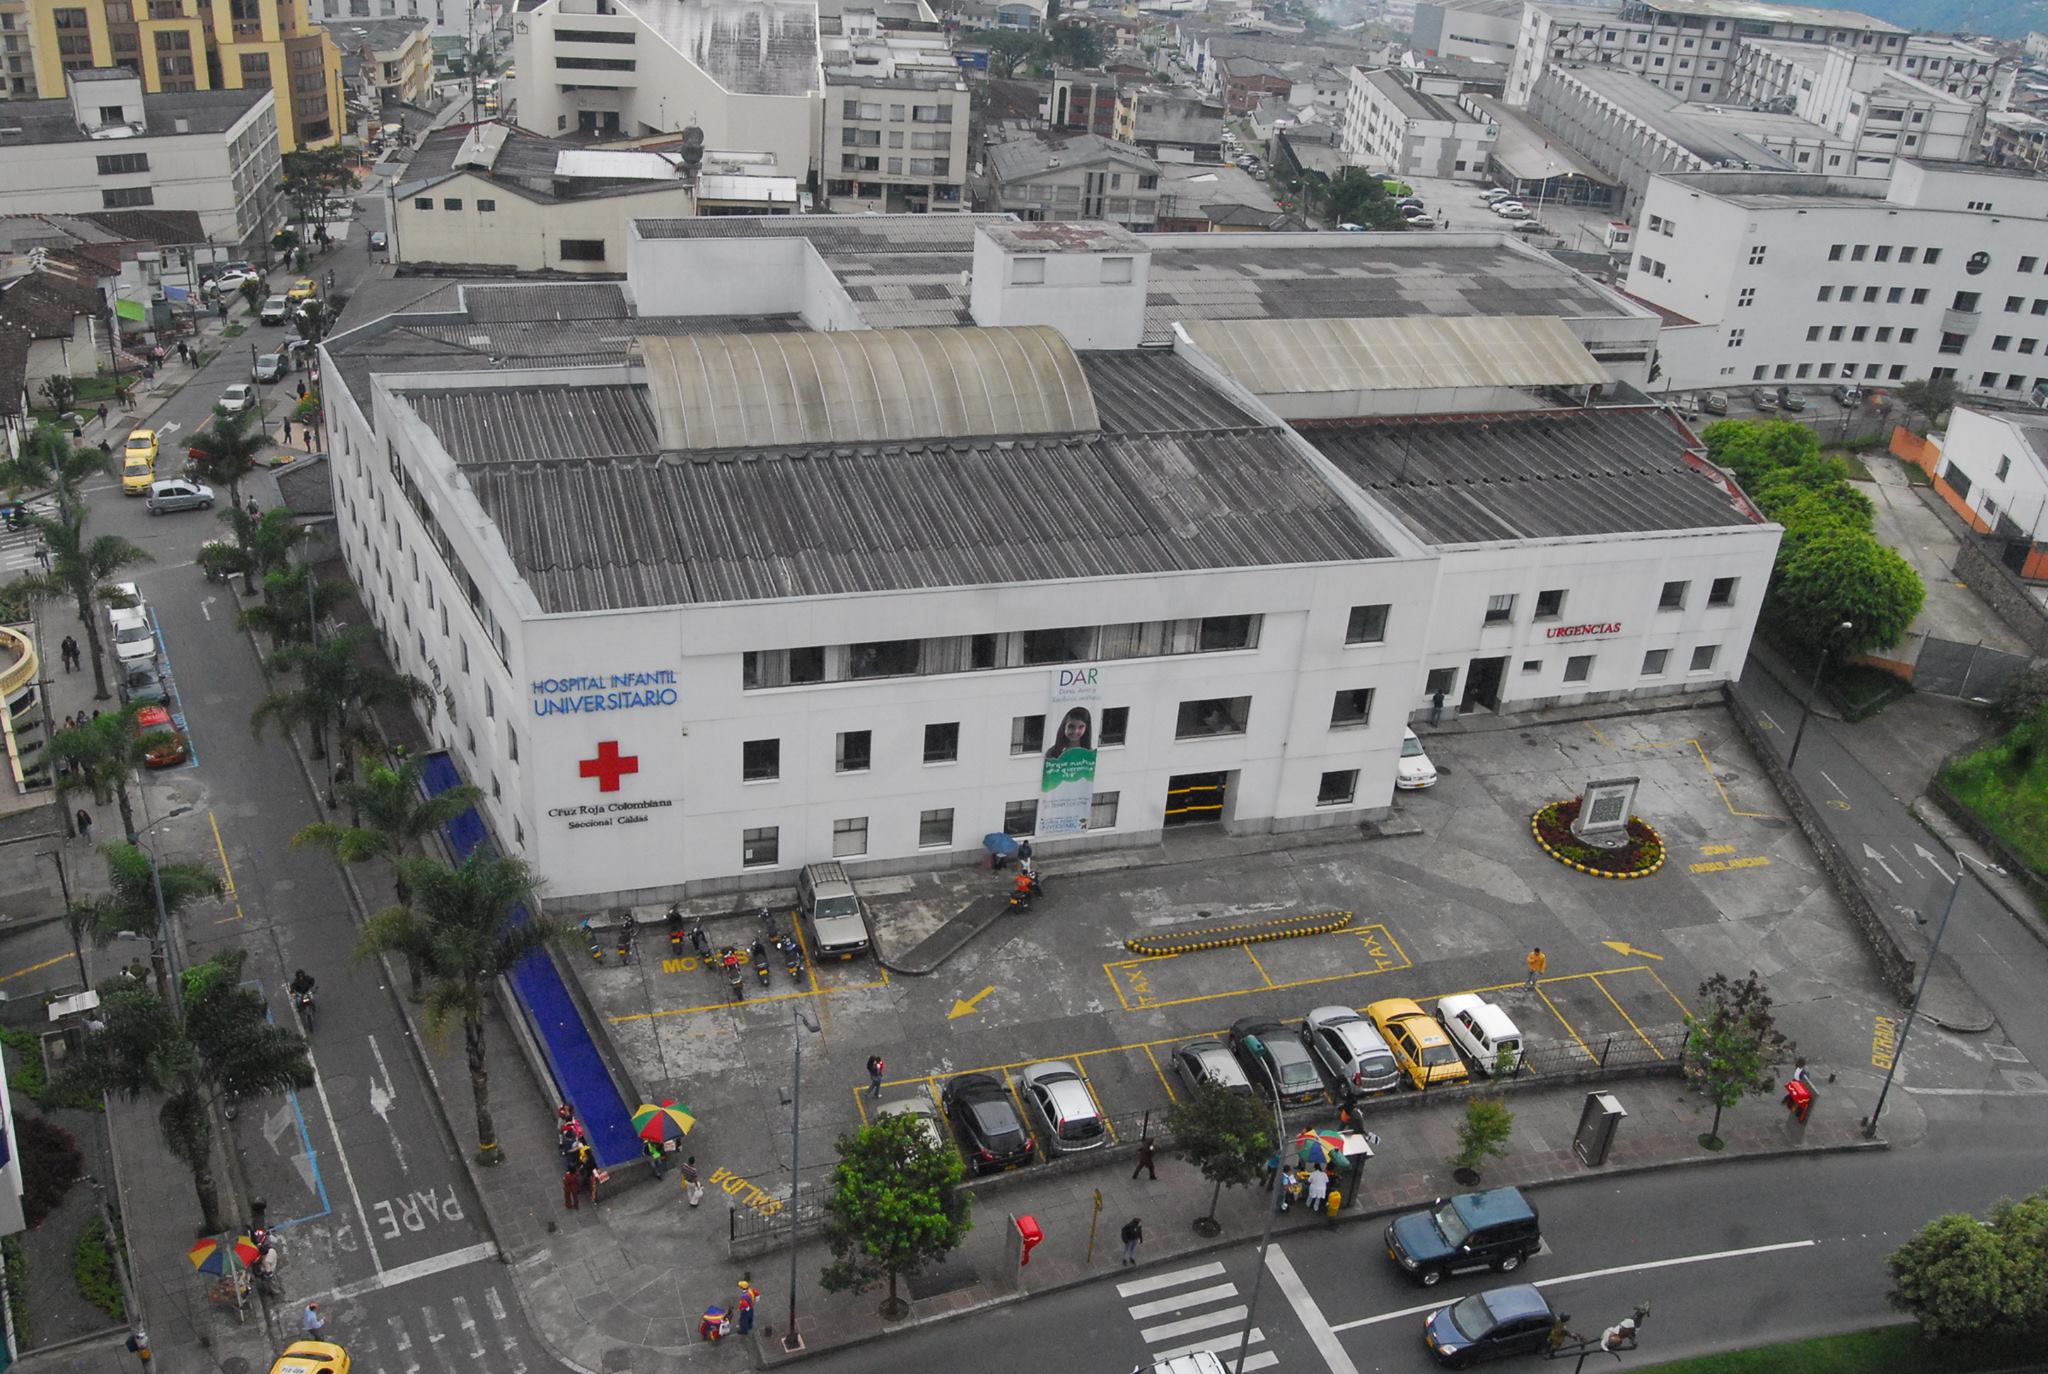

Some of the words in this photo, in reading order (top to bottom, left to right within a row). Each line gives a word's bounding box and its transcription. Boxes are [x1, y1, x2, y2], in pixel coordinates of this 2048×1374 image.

[1546, 622, 1622, 638] URGENCIAS
[532, 676, 606, 694] HOSPITAL
[611, 670, 677, 688] INFANTIL
[1059, 667, 1098, 687] DAR
[534, 688, 678, 716] UNIVERSITARIO
[548, 808, 577, 818] Cruz
[579, 804, 605, 816] Roja
[608, 799, 672, 813] Colombiana
[568, 817, 613, 829] Seccional
[617, 814, 648, 825] Caldas
[662, 950, 750, 975] MOS
[1355, 930, 1393, 970] TAXI
[1122, 963, 1159, 1006] TAXI
[1871, 1015, 1896, 1070] ENTRADA
[708, 1166, 784, 1217] SALIDA
[373, 1184, 465, 1240] PARE
